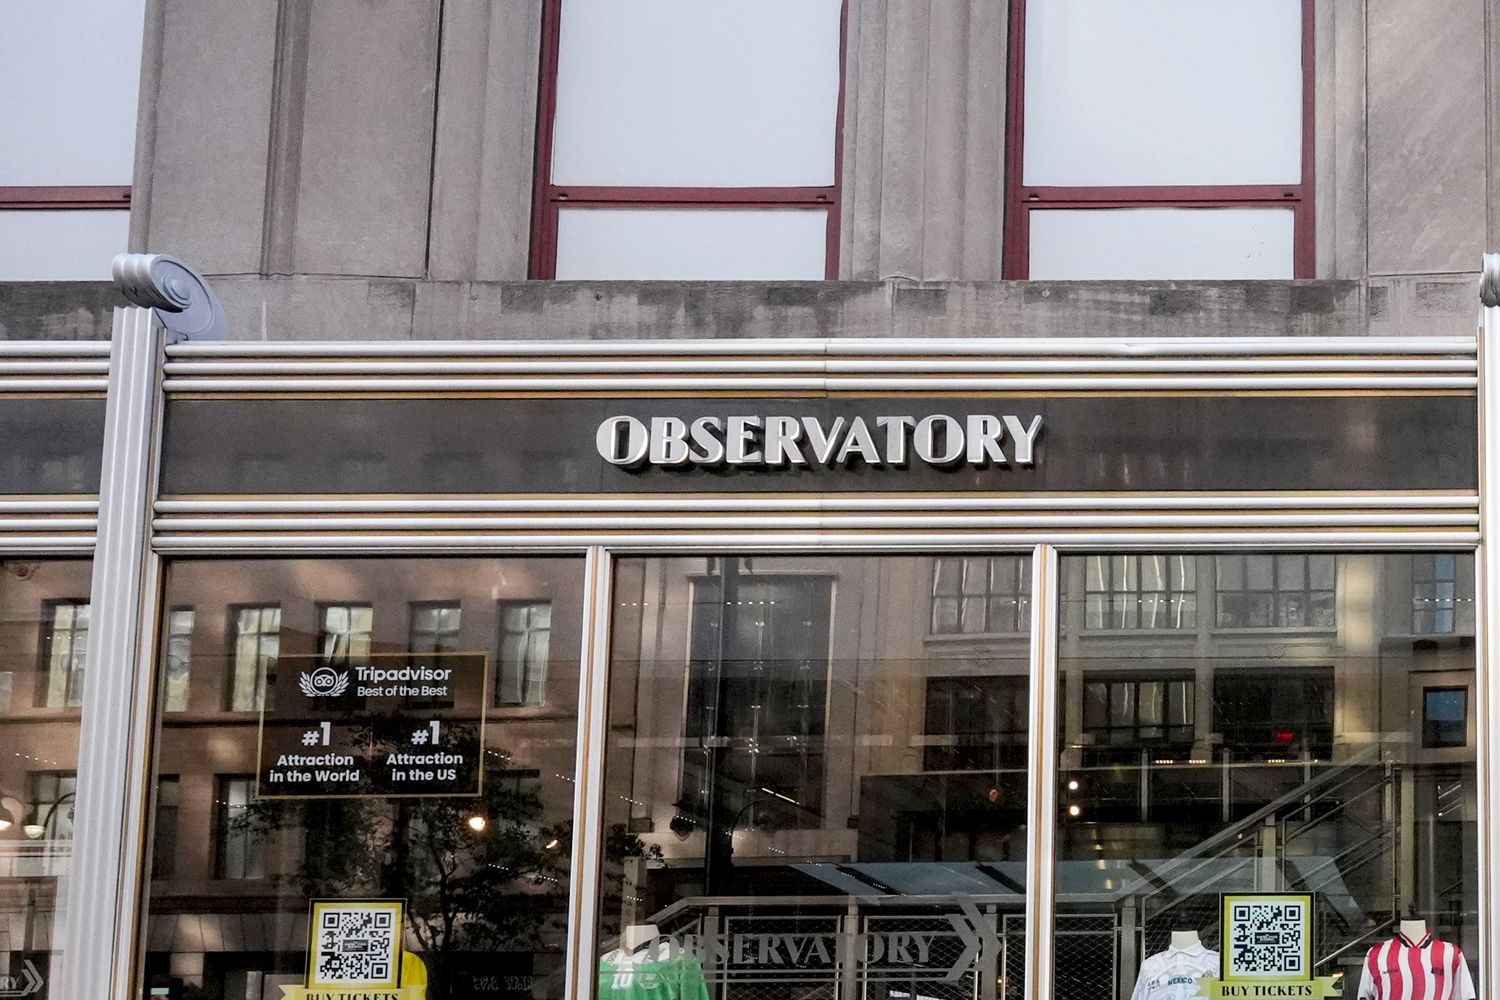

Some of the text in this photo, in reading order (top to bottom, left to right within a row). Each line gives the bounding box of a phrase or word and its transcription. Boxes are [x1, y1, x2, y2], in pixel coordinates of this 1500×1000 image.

[596, 415, 1043, 465] OBSERVATORY
[355, 666, 452, 683] Tripadvisor
[357, 685, 448, 697] Best of the Best
[301, 721, 331, 746] #1
[411, 720, 440, 745] #1
[277, 753, 354, 766] Attraction
[386, 752, 463, 765] Attraction
[269, 770, 360, 782] in the World
[392, 769, 456, 781] in the US
[1222, 985, 1313, 997] BUY TICKETS
